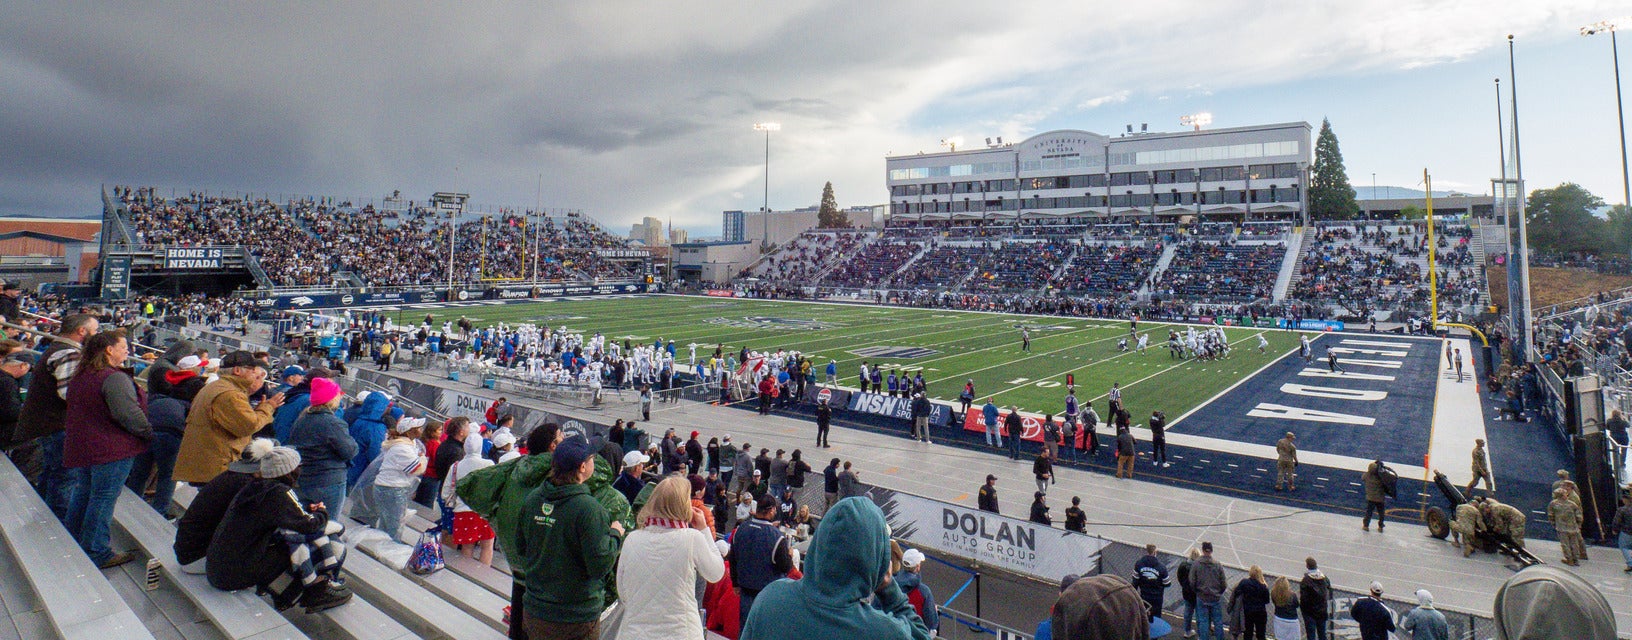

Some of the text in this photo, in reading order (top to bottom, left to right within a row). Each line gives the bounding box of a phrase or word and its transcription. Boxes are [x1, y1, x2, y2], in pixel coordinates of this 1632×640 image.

[167, 249, 221, 258] HOME IS
[168, 259, 219, 268] NEVADA
[457, 395, 487, 413] DOLAN
[854, 393, 941, 416] NSN NEDA
[943, 508, 1035, 551] DOLAN
[942, 532, 1036, 561] AUTO GROUP
[965, 546, 978, 554] AND
[1012, 559, 1036, 569] FAMILY
